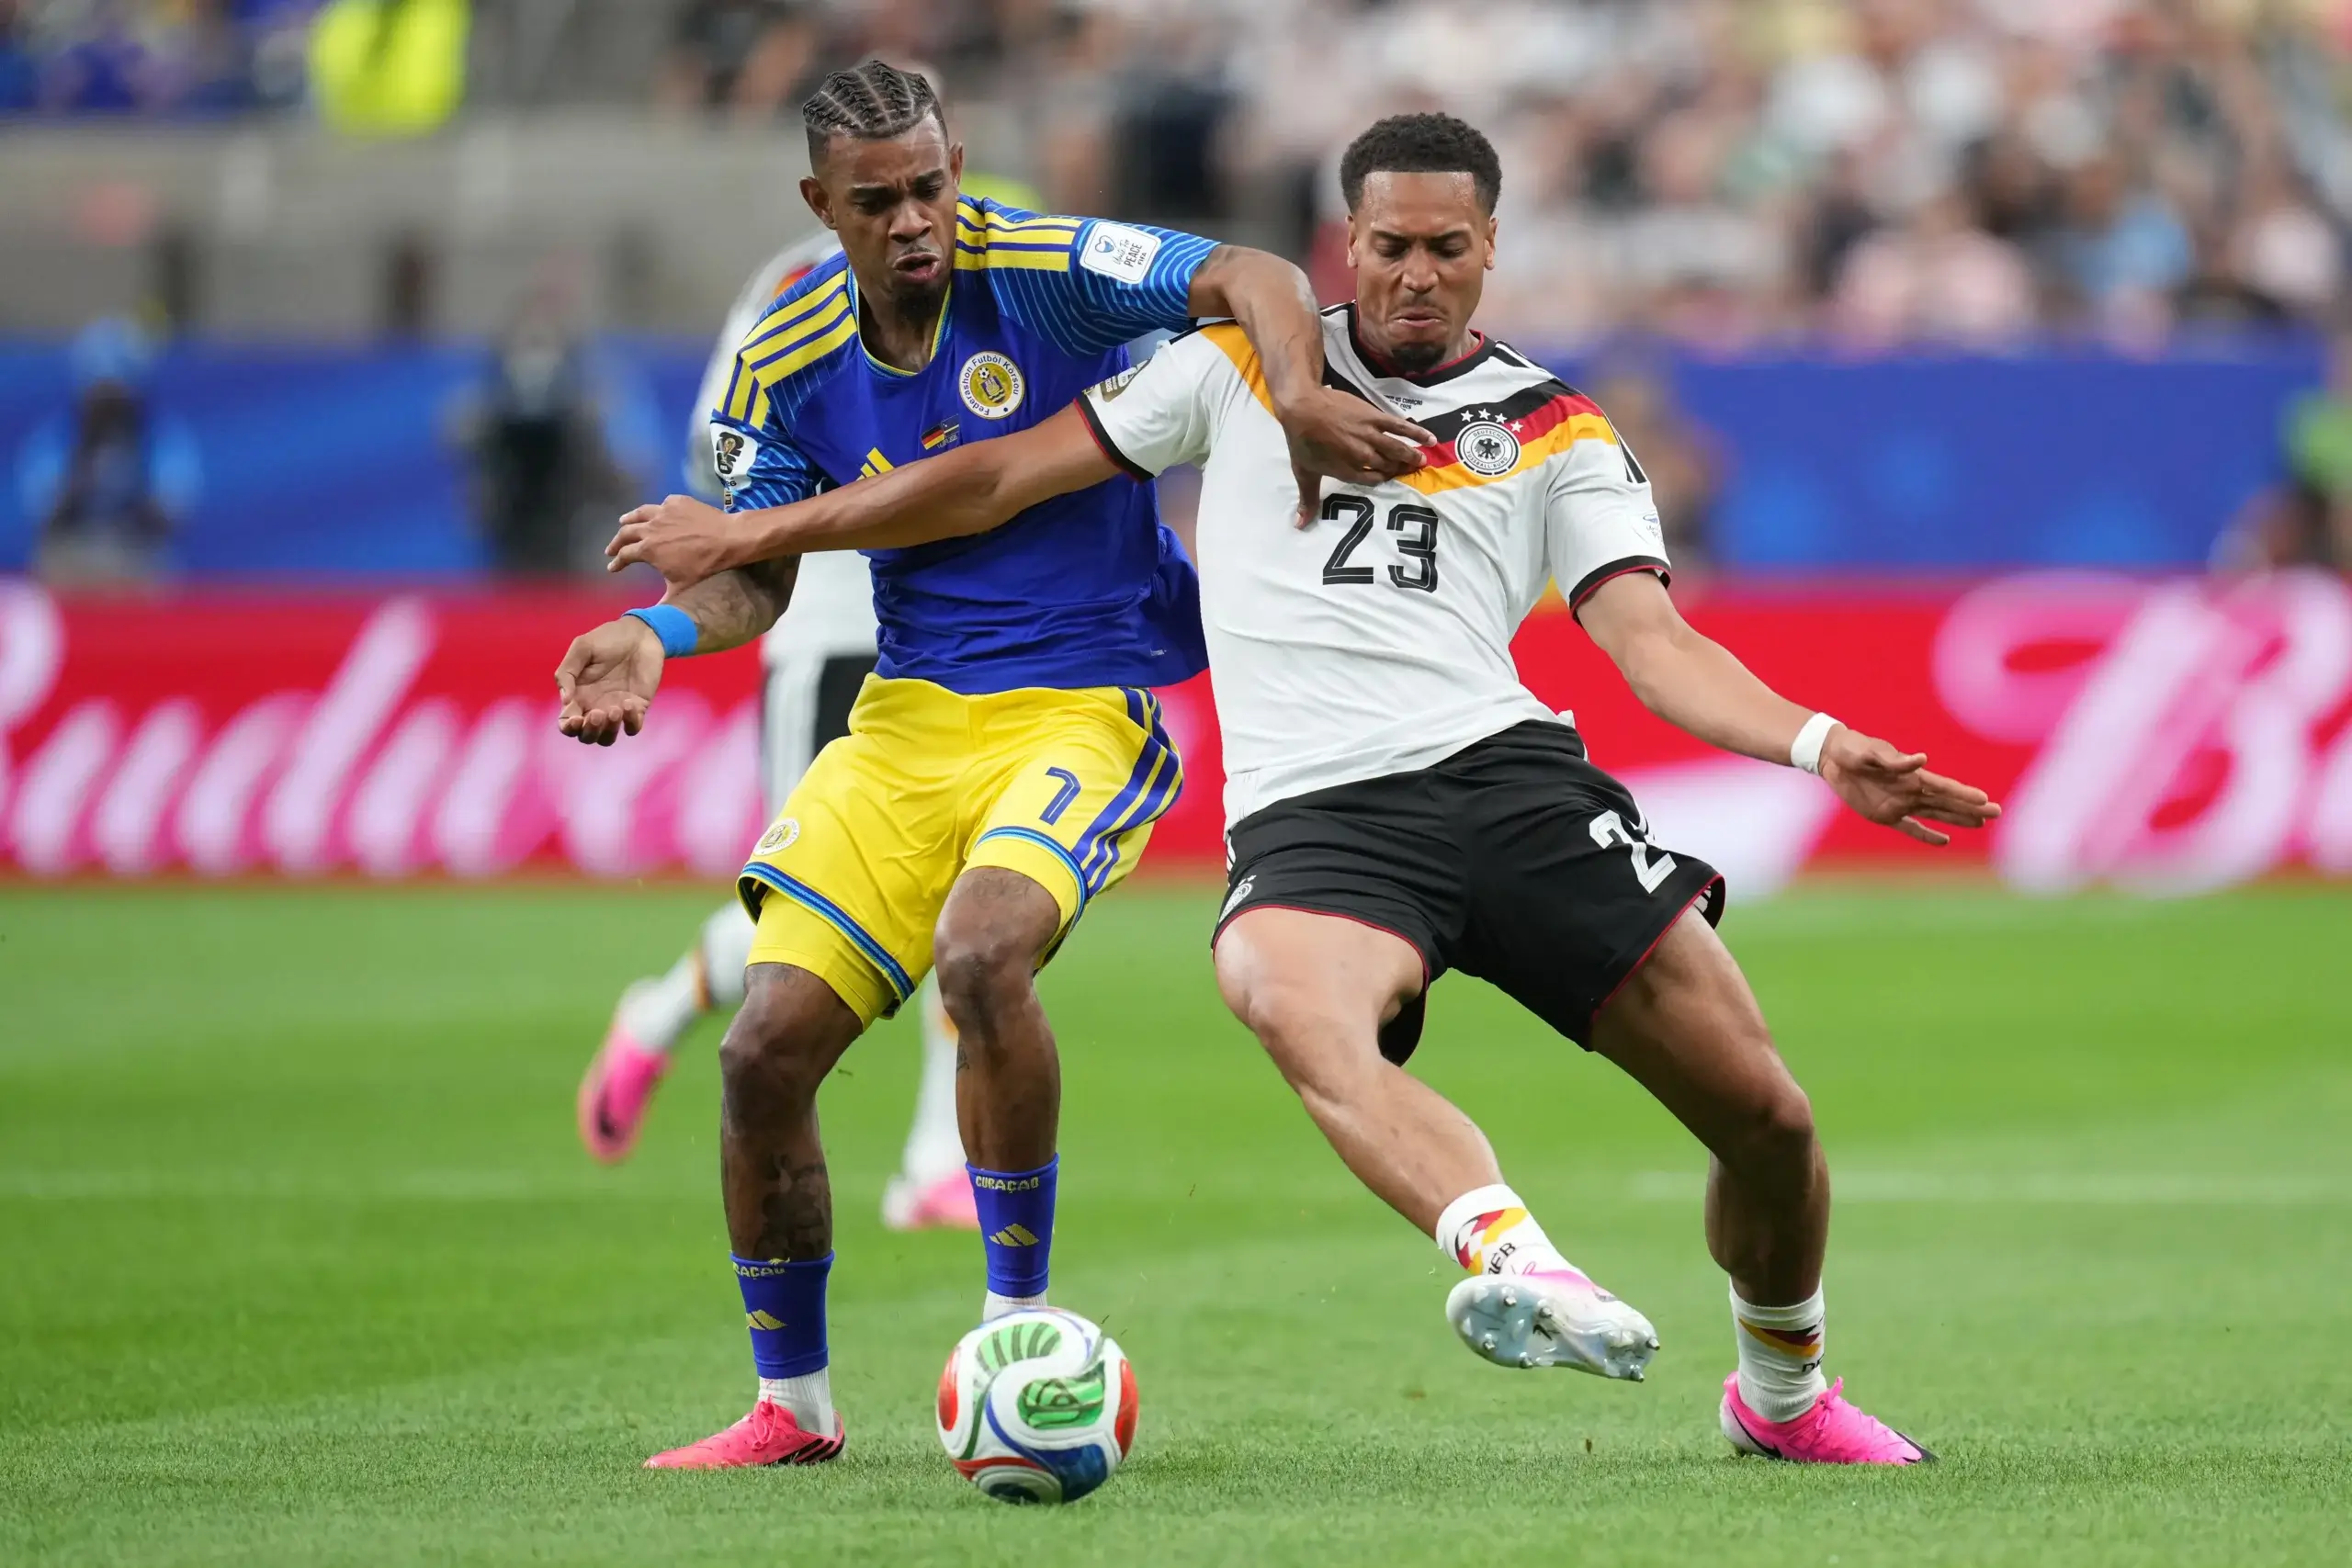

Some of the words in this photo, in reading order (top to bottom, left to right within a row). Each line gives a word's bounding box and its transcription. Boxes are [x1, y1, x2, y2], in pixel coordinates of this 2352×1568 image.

[1124, 243, 1143, 268] PEACE
[1137, 252, 1148, 265] FIFA
[962, 367, 990, 416] Federashon
[1473, 428, 1508, 442] DEUTSCHER
[1321, 492, 1439, 593] 23
[1038, 766, 1081, 826] 7
[1589, 809, 1677, 894] 2
[976, 1175, 1039, 1194] CURAÇAO
